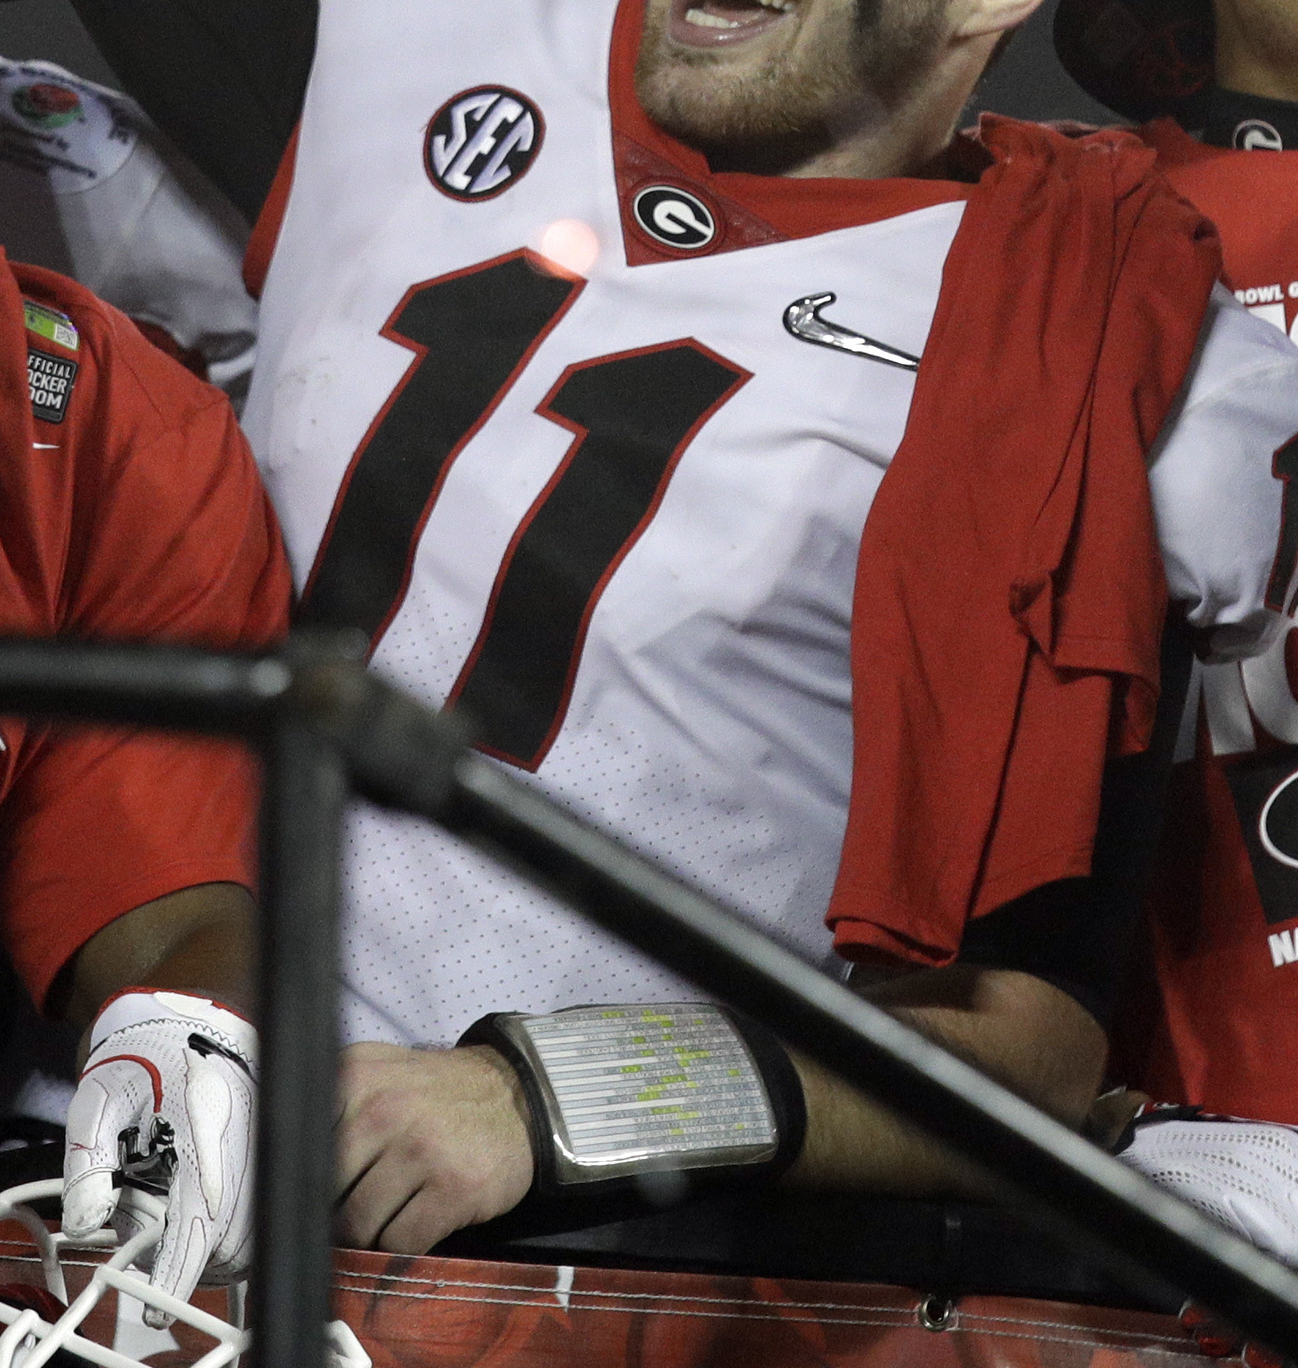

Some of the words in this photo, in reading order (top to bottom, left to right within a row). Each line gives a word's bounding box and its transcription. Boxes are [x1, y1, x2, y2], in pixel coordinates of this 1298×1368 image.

[427, 88, 541, 197] SEC
[1235, 284, 1284, 305] BOWL
[28, 355, 71, 379] FFICIAL
[27, 369, 67, 394] OCKER
[29, 386, 63, 409] OOM
[299, 246, 755, 773] 11
